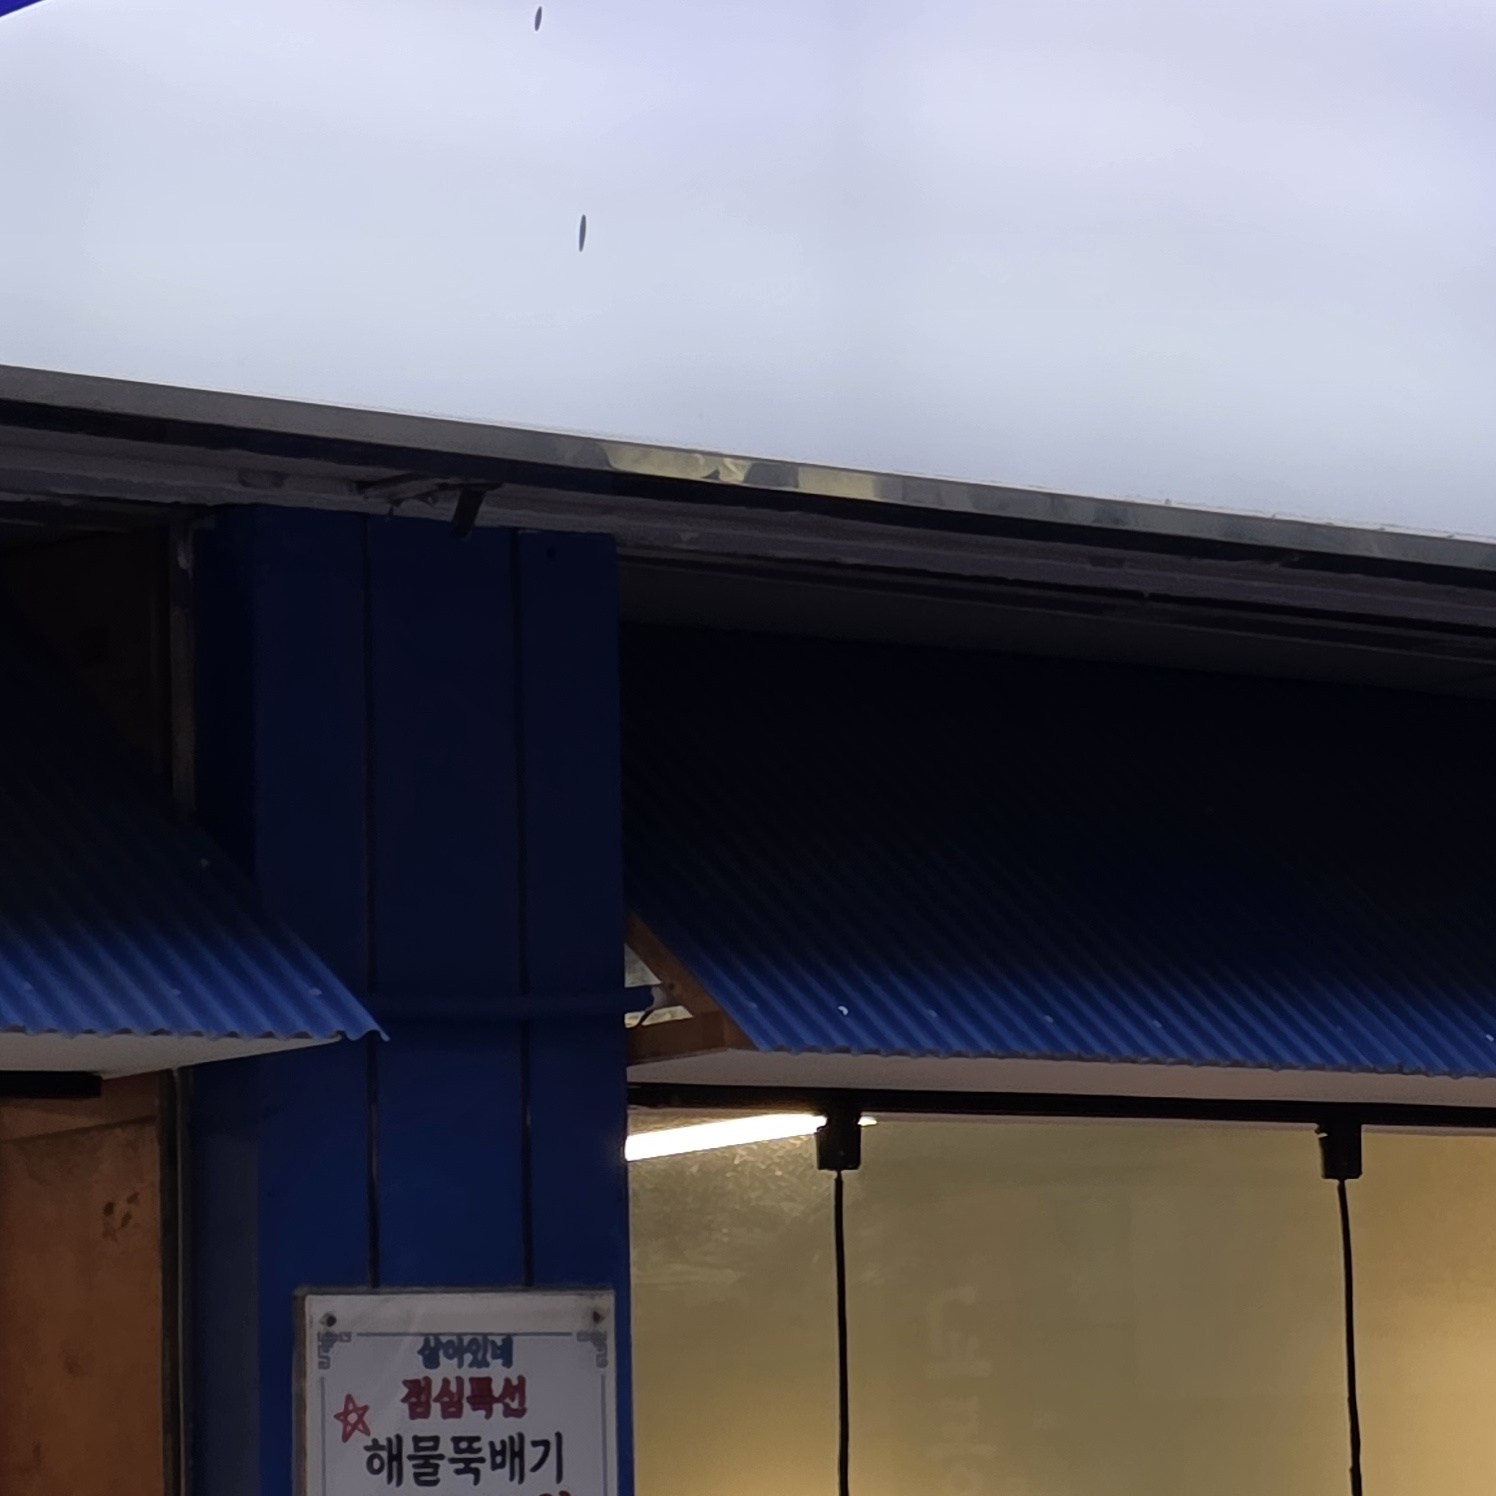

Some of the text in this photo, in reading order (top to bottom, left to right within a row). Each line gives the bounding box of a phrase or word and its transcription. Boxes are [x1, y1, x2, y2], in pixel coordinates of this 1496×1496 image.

[417, 1334, 514, 1370] 살아있네
[401, 1375, 528, 1420] 점심특선
[363, 1431, 564, 1488] 해물뚝배기
